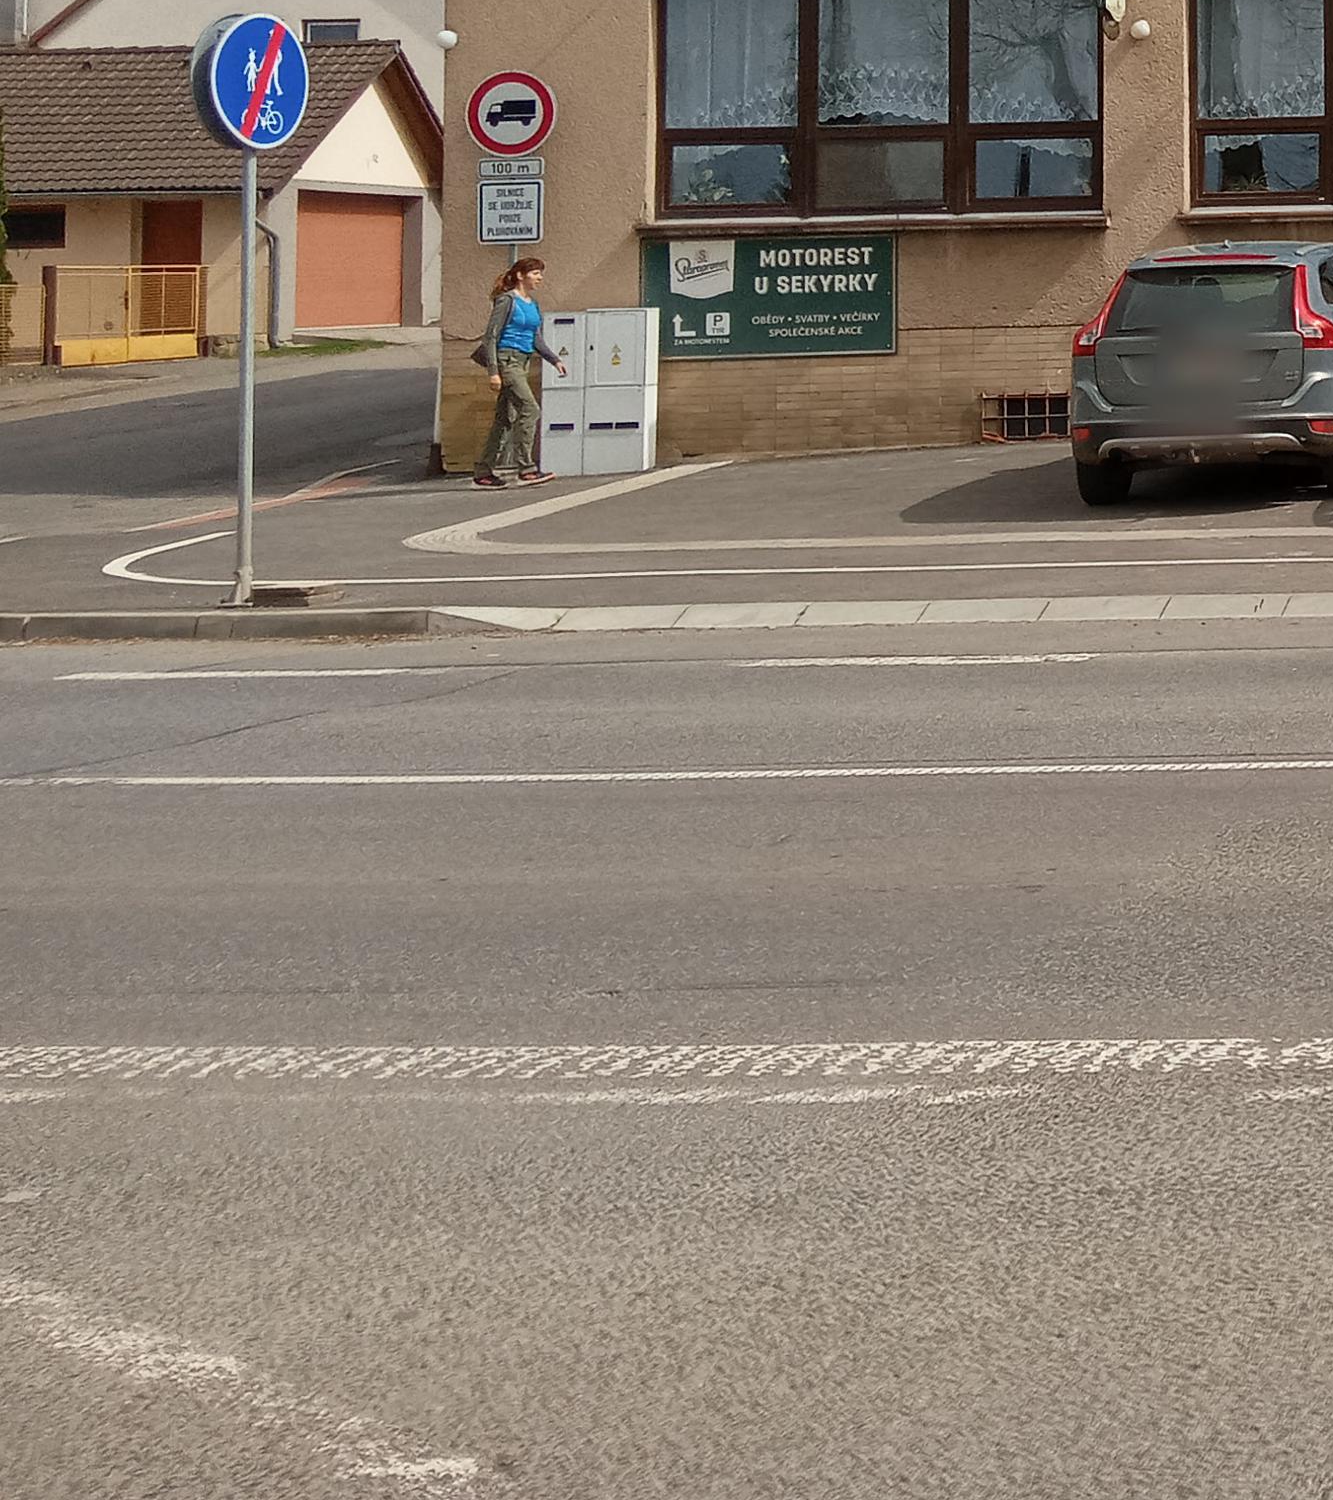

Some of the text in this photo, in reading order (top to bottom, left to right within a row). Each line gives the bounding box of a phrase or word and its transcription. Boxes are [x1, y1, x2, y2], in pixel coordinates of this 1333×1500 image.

[491, 163, 530, 174] 100 m
[760, 246, 874, 268] MOTOREST
[754, 273, 879, 295] U SEKYRKY
[713, 314, 724, 327] P
[751, 311, 881, 325] OBĚDY SVATBY VEČÍRKY
[768, 326, 863, 338] SPOLEČENSKÉ AKCE
